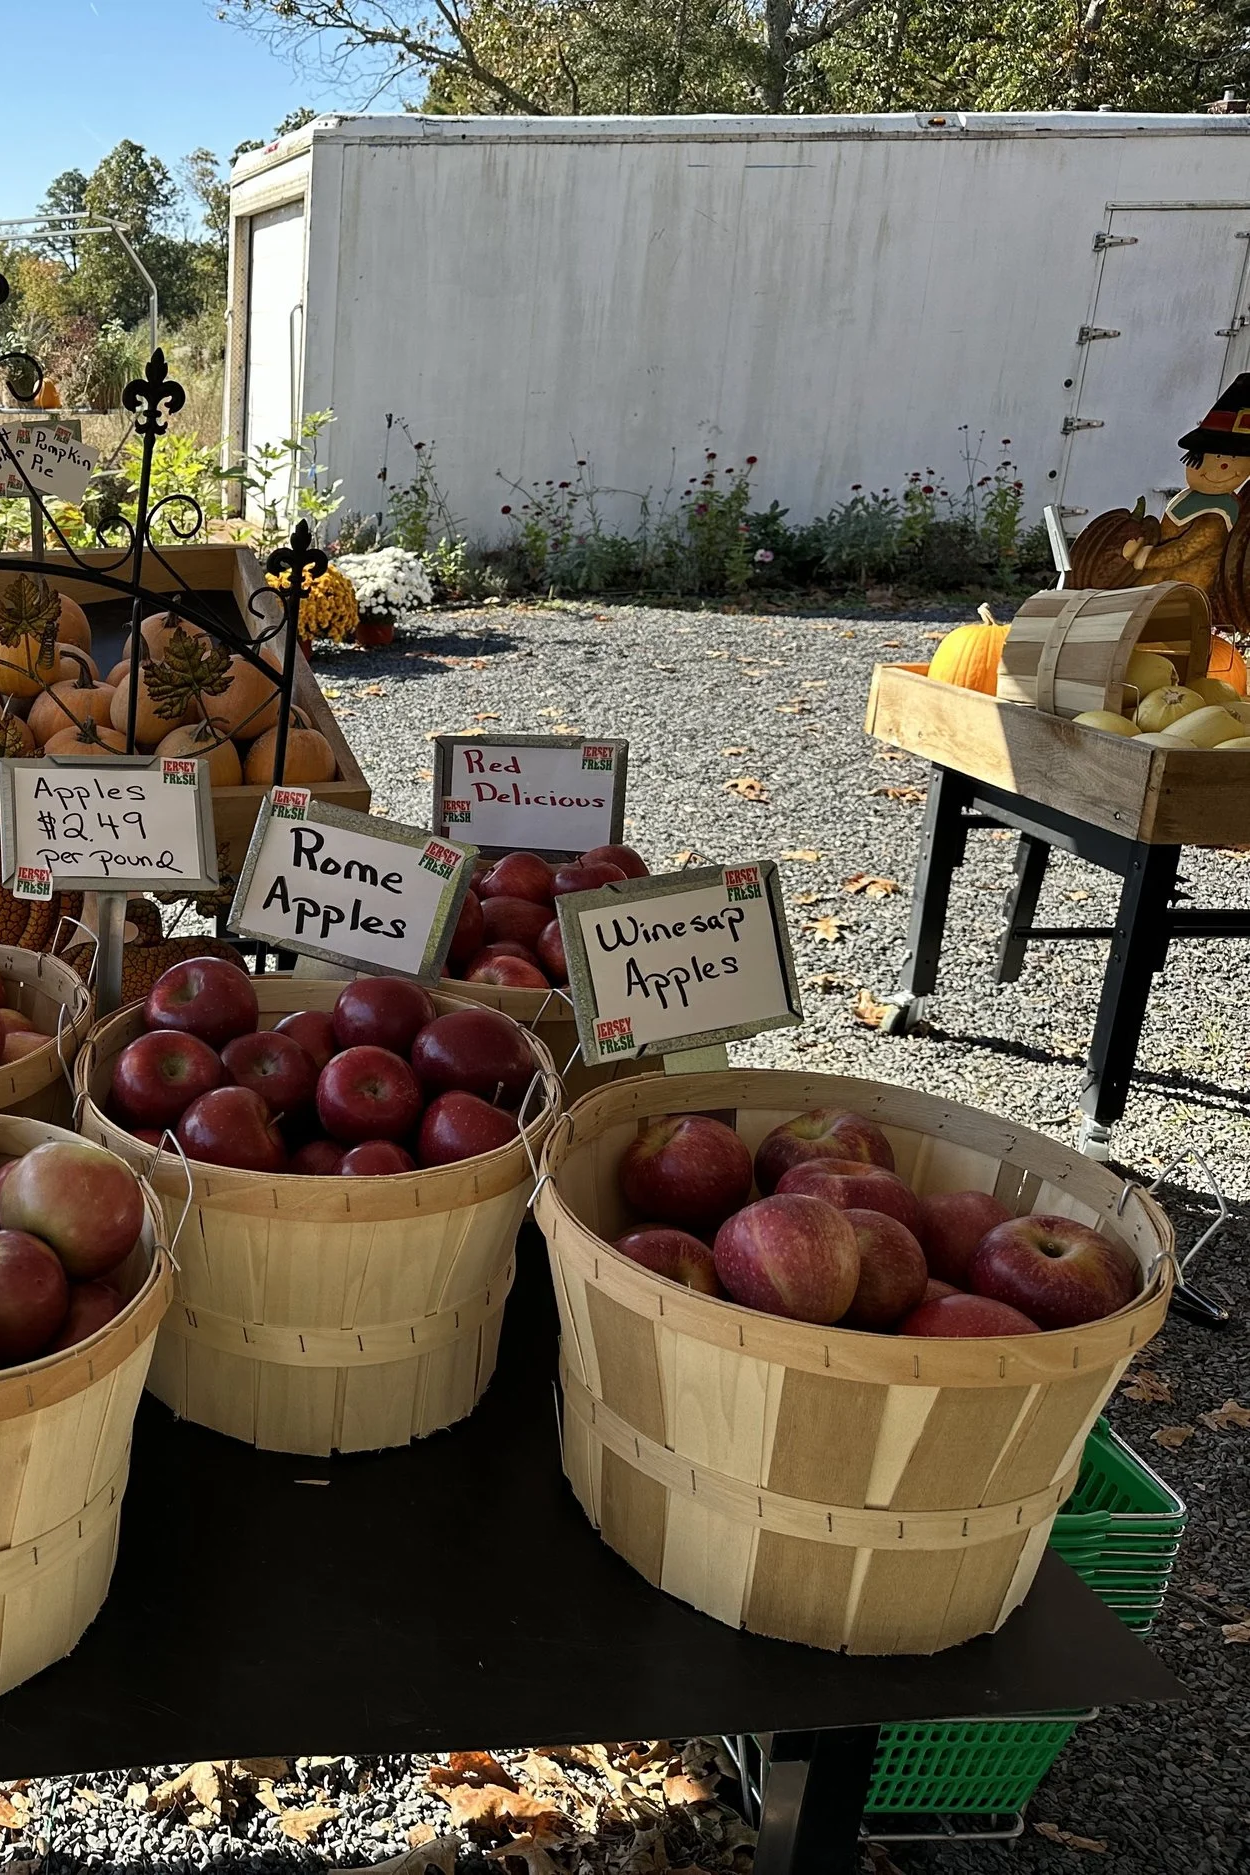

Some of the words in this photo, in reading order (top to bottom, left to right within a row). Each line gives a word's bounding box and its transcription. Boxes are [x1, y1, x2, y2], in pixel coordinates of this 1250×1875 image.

[37, 431, 91, 471] Pumpkin
[31, 454, 54, 478] Pie
[463, 749, 522, 774] Red
[583, 746, 614, 758] JERSEY
[163, 760, 196, 773] JERSEY
[581, 758, 613, 771] FRESH
[163, 773, 196, 786] FRESH
[33, 776, 146, 810] Apples
[273, 792, 308, 806] JERSEY
[471, 782, 606, 808] Delicious
[271, 805, 305, 821] FRESH
[443, 800, 471, 811] JERSEY
[443, 811, 472, 823] FRESH
[37, 810, 147, 842] $2.49
[36, 849, 84, 874] per
[89, 850, 184, 876] pound
[290, 827, 403, 894] Rome
[425, 840, 462, 867] JERSEY
[18, 867, 50, 881] JERSEY
[418, 856, 455, 881] FRESH
[725, 866, 759, 886] JERSEY
[16, 881, 50, 896] FRESH
[727, 883, 763, 902] FRESH
[262, 875, 407, 939] Apples
[595, 907, 745, 952] Winesap
[626, 956, 739, 1010] Apples
[597, 1016, 631, 1037] JERSEY
[599, 1033, 635, 1056] FRESH
